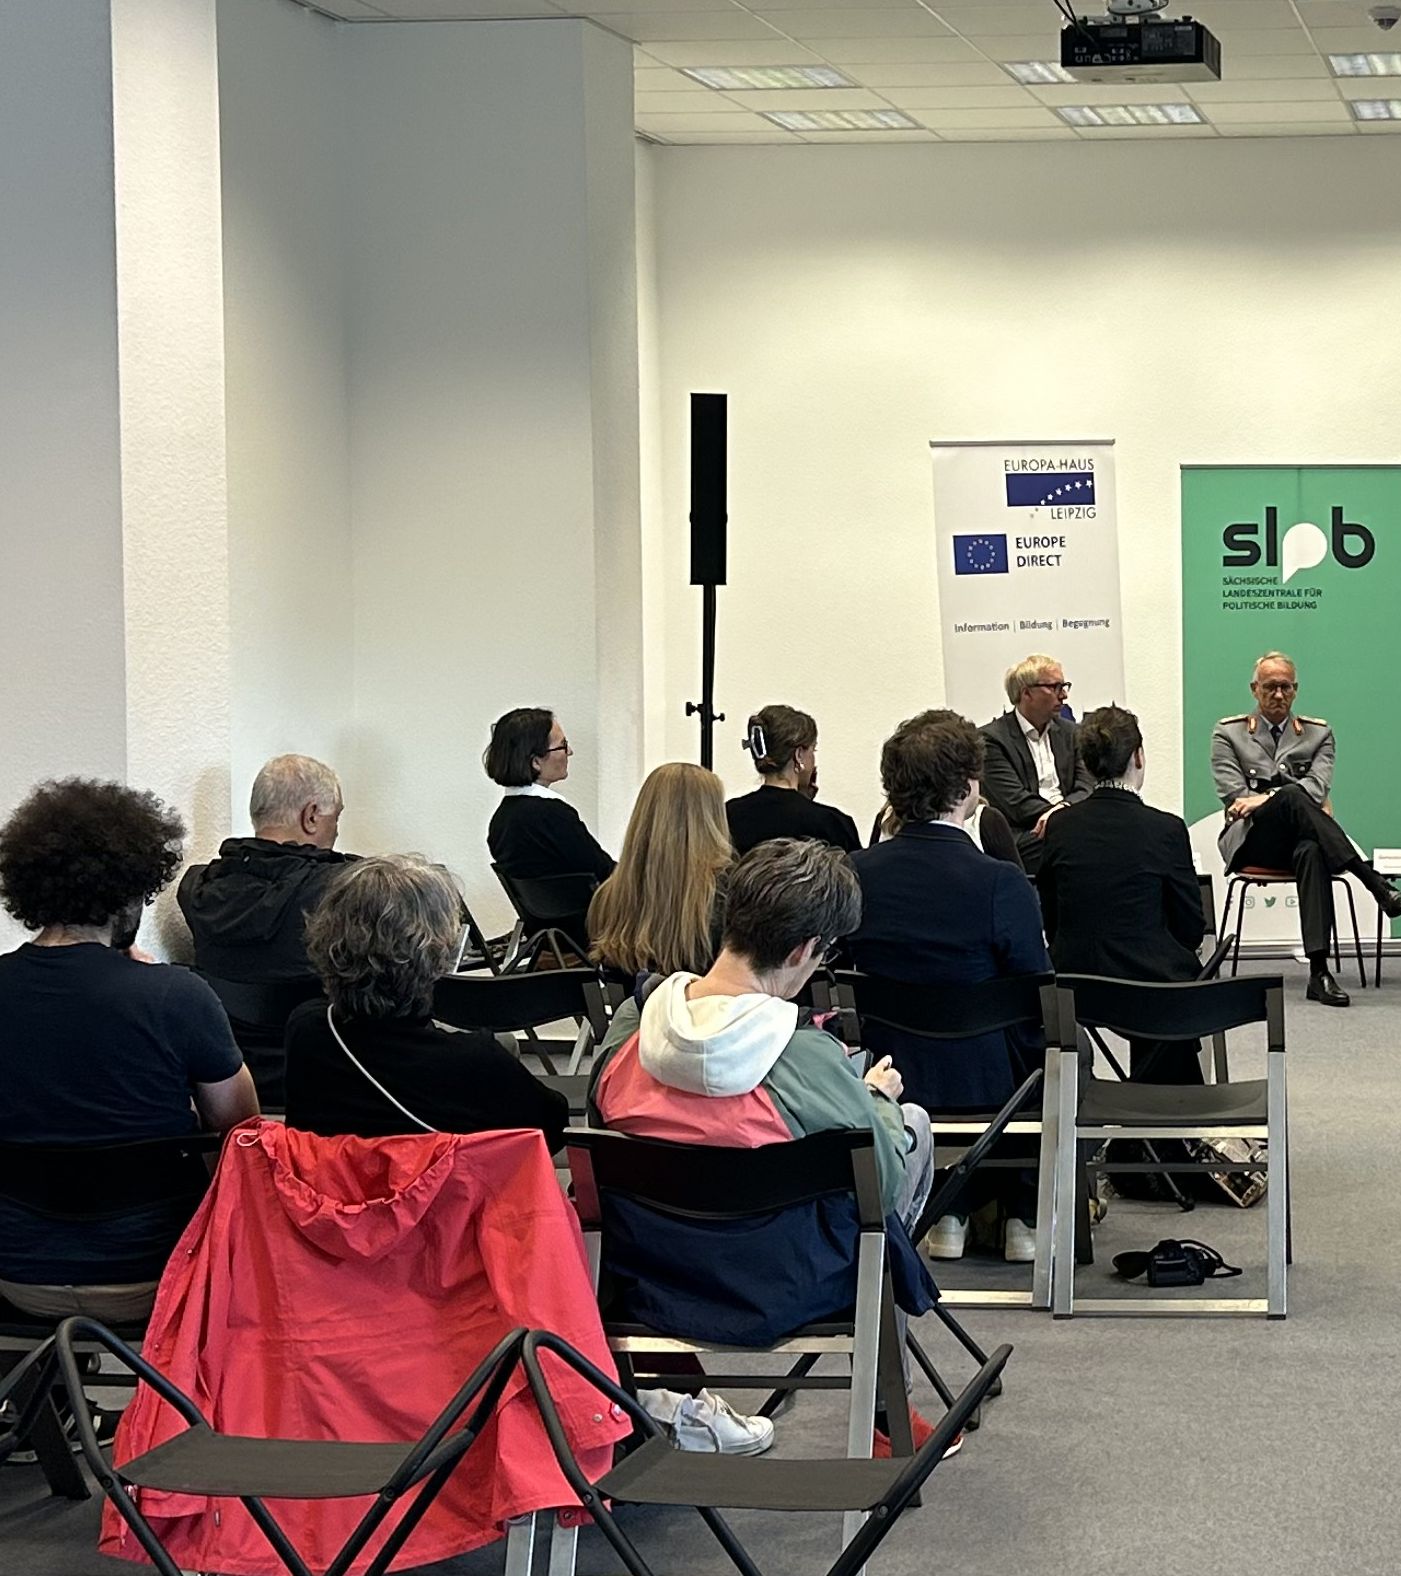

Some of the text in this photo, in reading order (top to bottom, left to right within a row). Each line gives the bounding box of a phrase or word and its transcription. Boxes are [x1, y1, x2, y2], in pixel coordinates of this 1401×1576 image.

[1004, 458, 1095, 472] EUROPA-HAUS
[1050, 507, 1097, 520] LEIPZIG
[1015, 536, 1066, 549] EUROPE
[1016, 554, 1062, 567] DIRECT
[1222, 576, 1278, 586] SÄCHSISCHE
[1222, 587, 1323, 598] LANDESZENTRALE FÜR
[1222, 601, 1317, 610] POLITISCHE BILDUNG
[954, 622, 1009, 633] Information
[1019, 620, 1053, 630] Bildung
